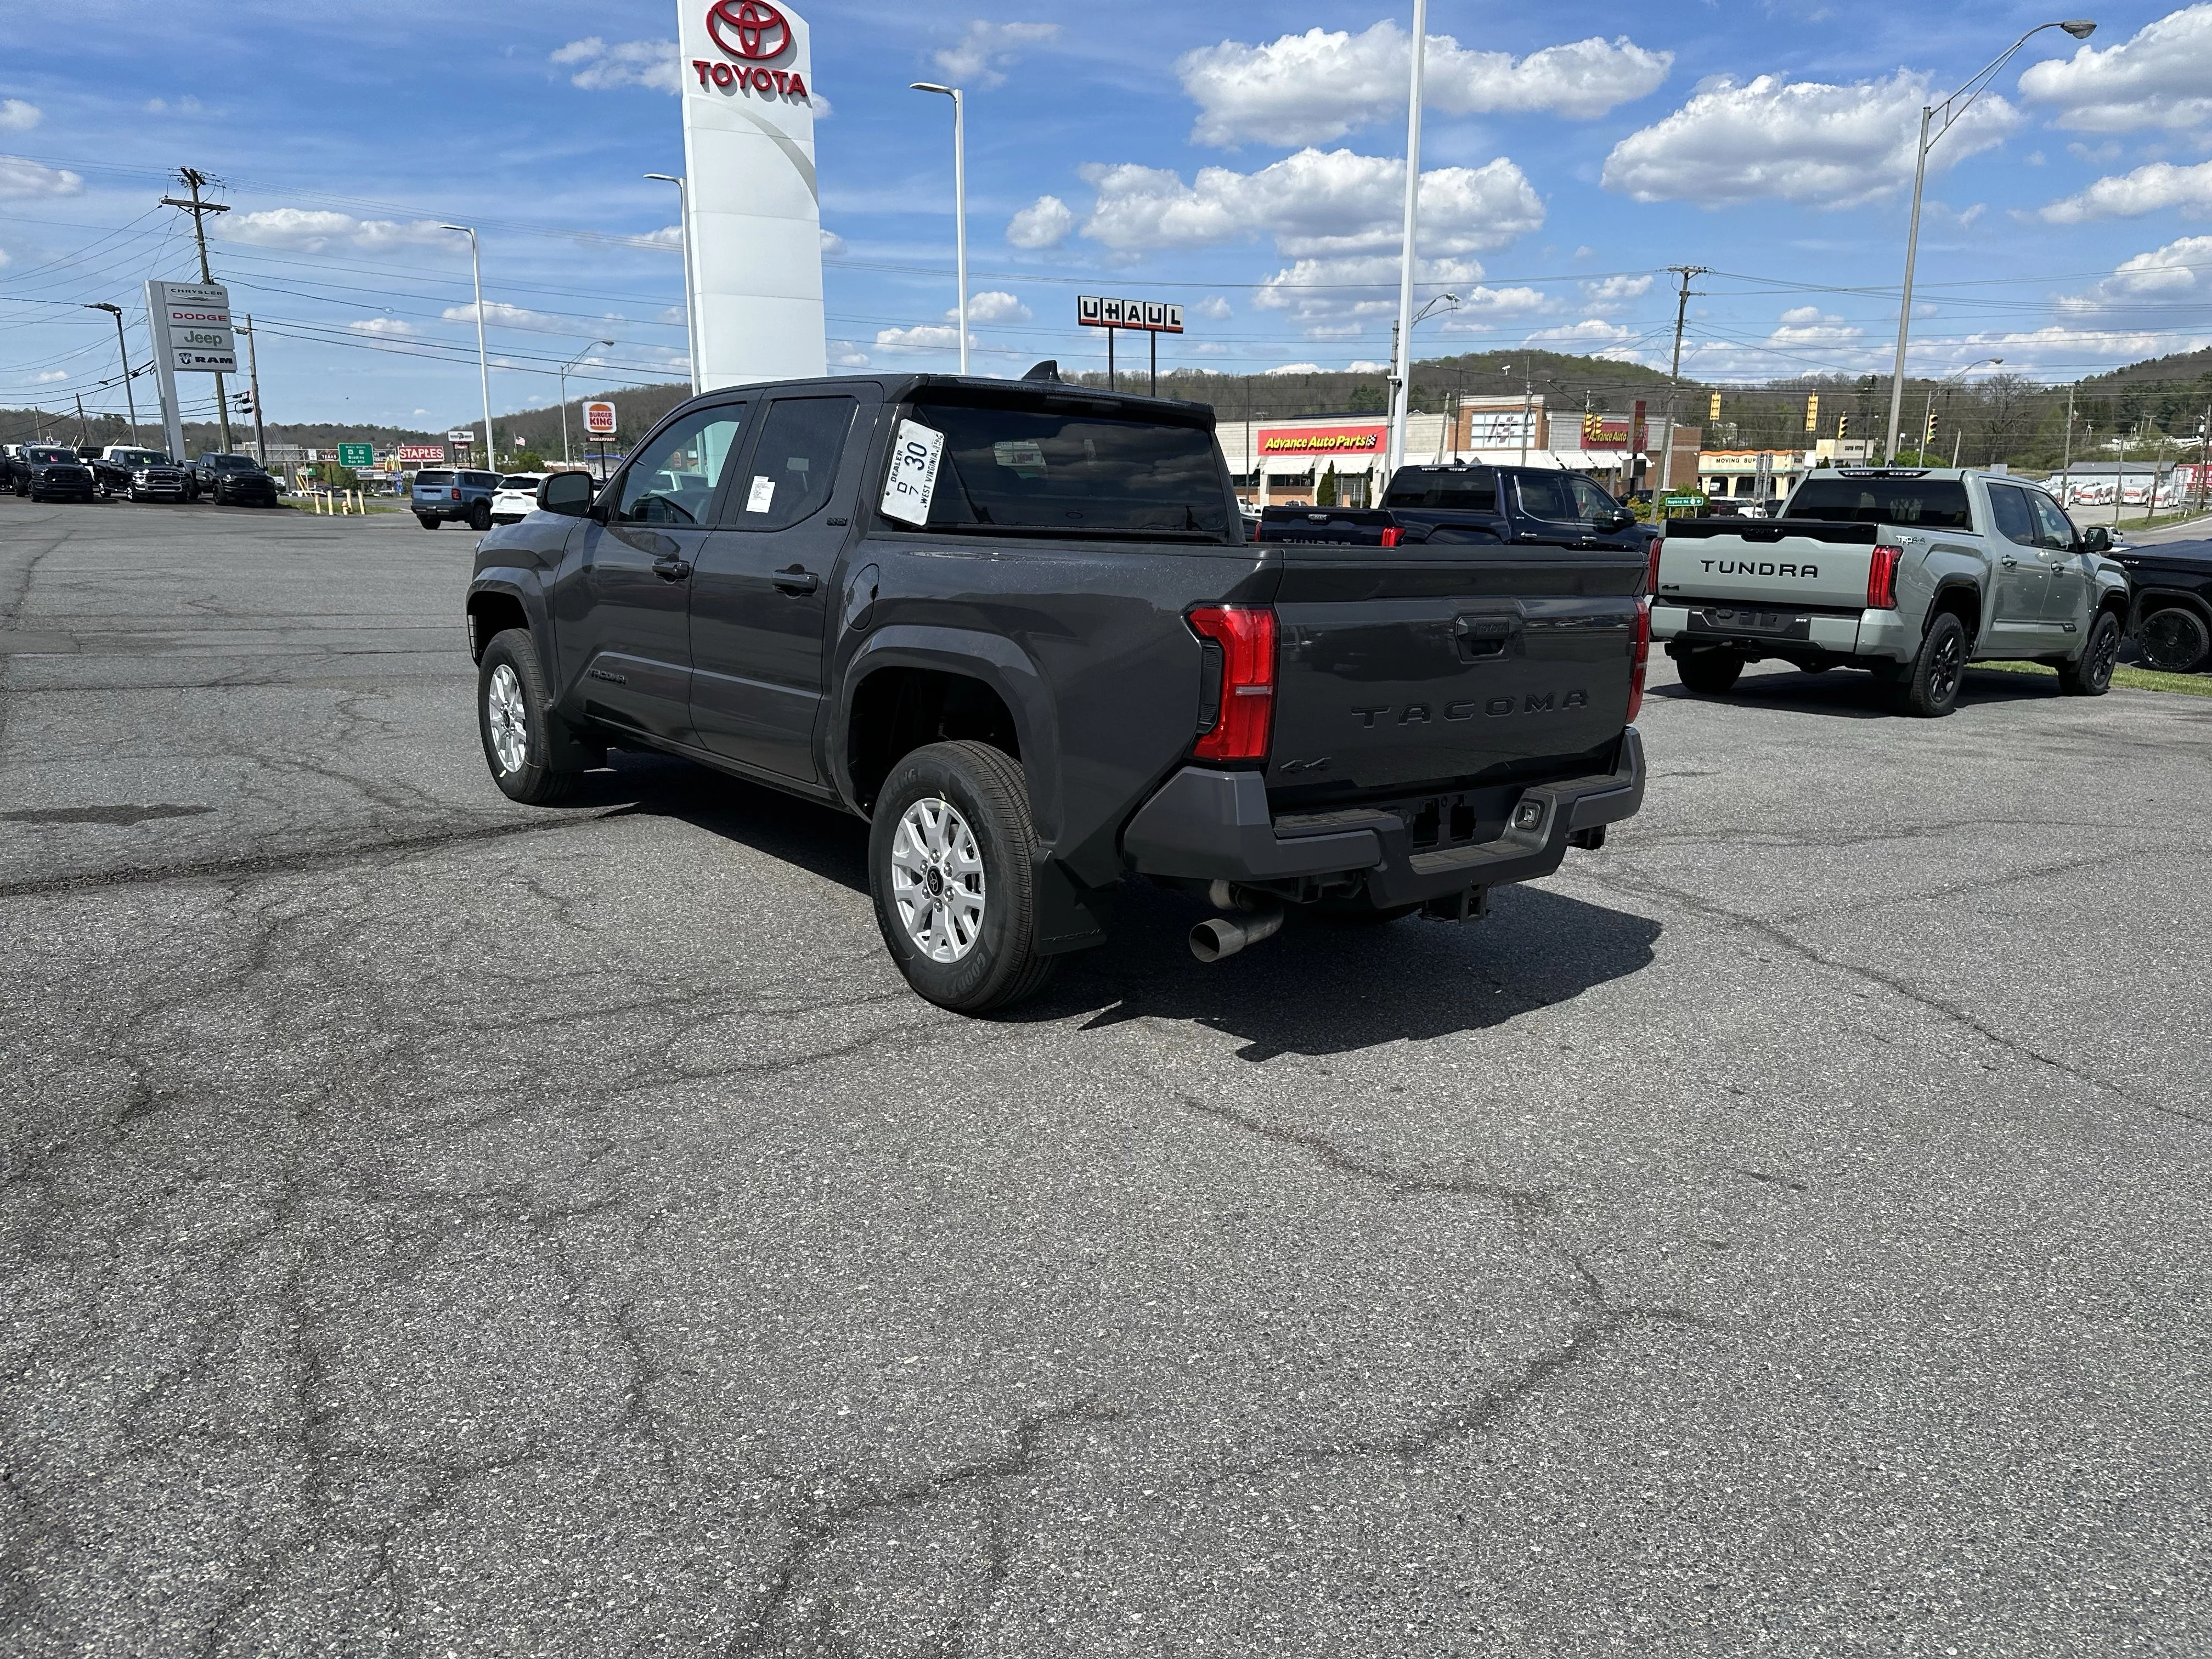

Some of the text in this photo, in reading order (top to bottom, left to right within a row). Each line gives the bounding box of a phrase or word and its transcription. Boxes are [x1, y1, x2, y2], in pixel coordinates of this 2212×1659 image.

[692, 60, 808, 97] TOYOTA
[172, 312, 227, 322] DODGE
[184, 330, 223, 347] Jeep
[195, 356, 233, 364] RAM
[590, 417, 613, 426] KING
[1265, 435, 1365, 449] Advance Auto Parts
[1612, 431, 1627, 442] Auto
[399, 448, 443, 459] STAPLES
[890, 450, 904, 483] DEALER
[896, 442, 928, 494] D 30
[925, 452, 938, 483] VIRGINIA
[920, 484, 932, 504] WEST
[1896, 535, 1913, 545] TRD
[1700, 560, 1818, 578] TUNDRA
[1479, 623, 1507, 633] TOYOTA
[589, 668, 625, 684] TACOMA
[1351, 689, 1589, 729] TACOMA
